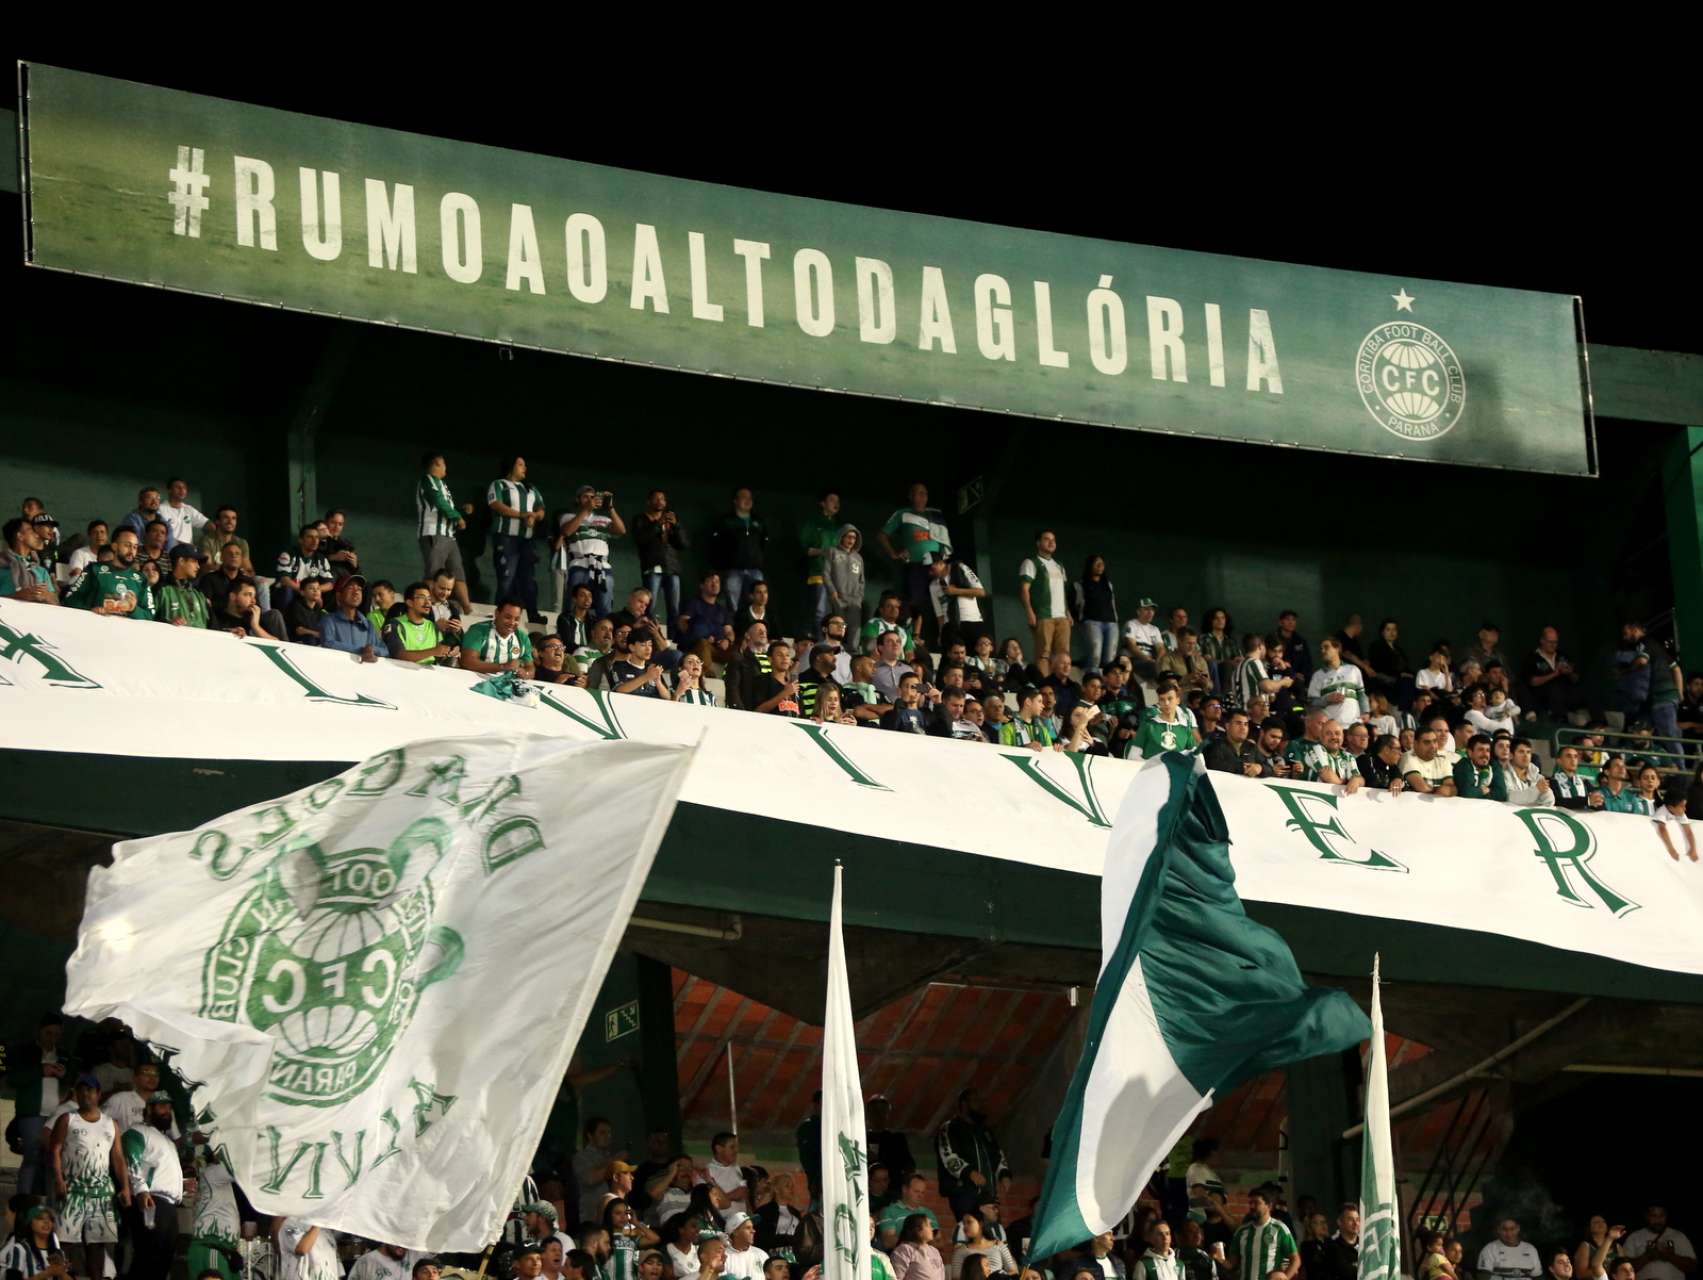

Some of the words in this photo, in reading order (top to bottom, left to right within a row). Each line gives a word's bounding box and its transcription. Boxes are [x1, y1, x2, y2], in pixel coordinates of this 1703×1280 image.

[167, 144, 1284, 396] #RUMOAOALTODAGLÓRIA
[1359, 334, 1385, 394] CORITIBA
[1384, 325, 1418, 340] FOOT
[1421, 332, 1450, 363] BALL
[1447, 365, 1462, 404] CLUB
[1381, 364, 1440, 396] CFC
